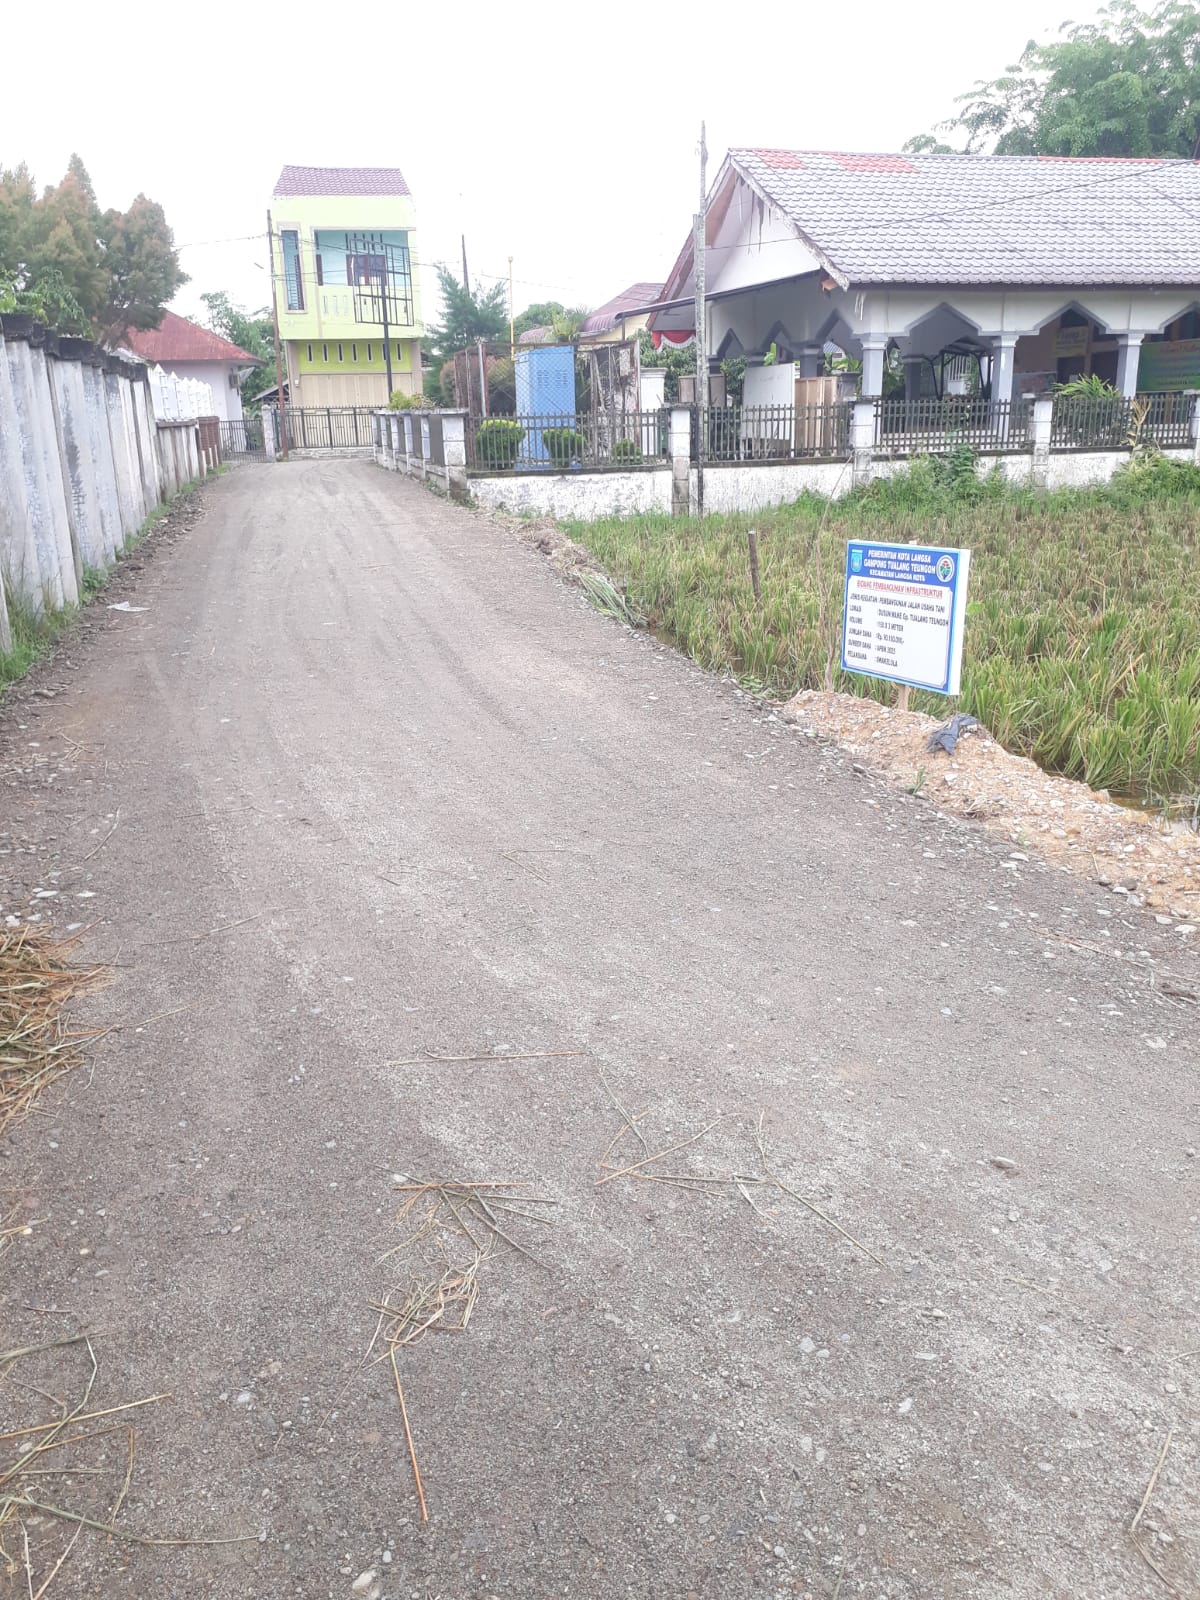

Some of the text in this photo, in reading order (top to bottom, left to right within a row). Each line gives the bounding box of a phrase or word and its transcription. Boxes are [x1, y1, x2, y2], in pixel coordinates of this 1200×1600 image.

[897, 552, 910, 561] KOTA
[911, 553, 931, 563] LANGSA
[863, 558, 936, 574] GAMPONG TUALANG TEUNGOH
[869, 569, 926, 582] KECAMATAN LANGSA KOTA
[857, 579, 872, 589] BIDANG
[905, 585, 943, 599] INFRASTRUKTUR
[907, 601, 921, 610] JALAN
[921, 603, 935, 612] USAHA
[935, 605, 946, 613] TANI
[910, 614, 929, 624] TUALANG
